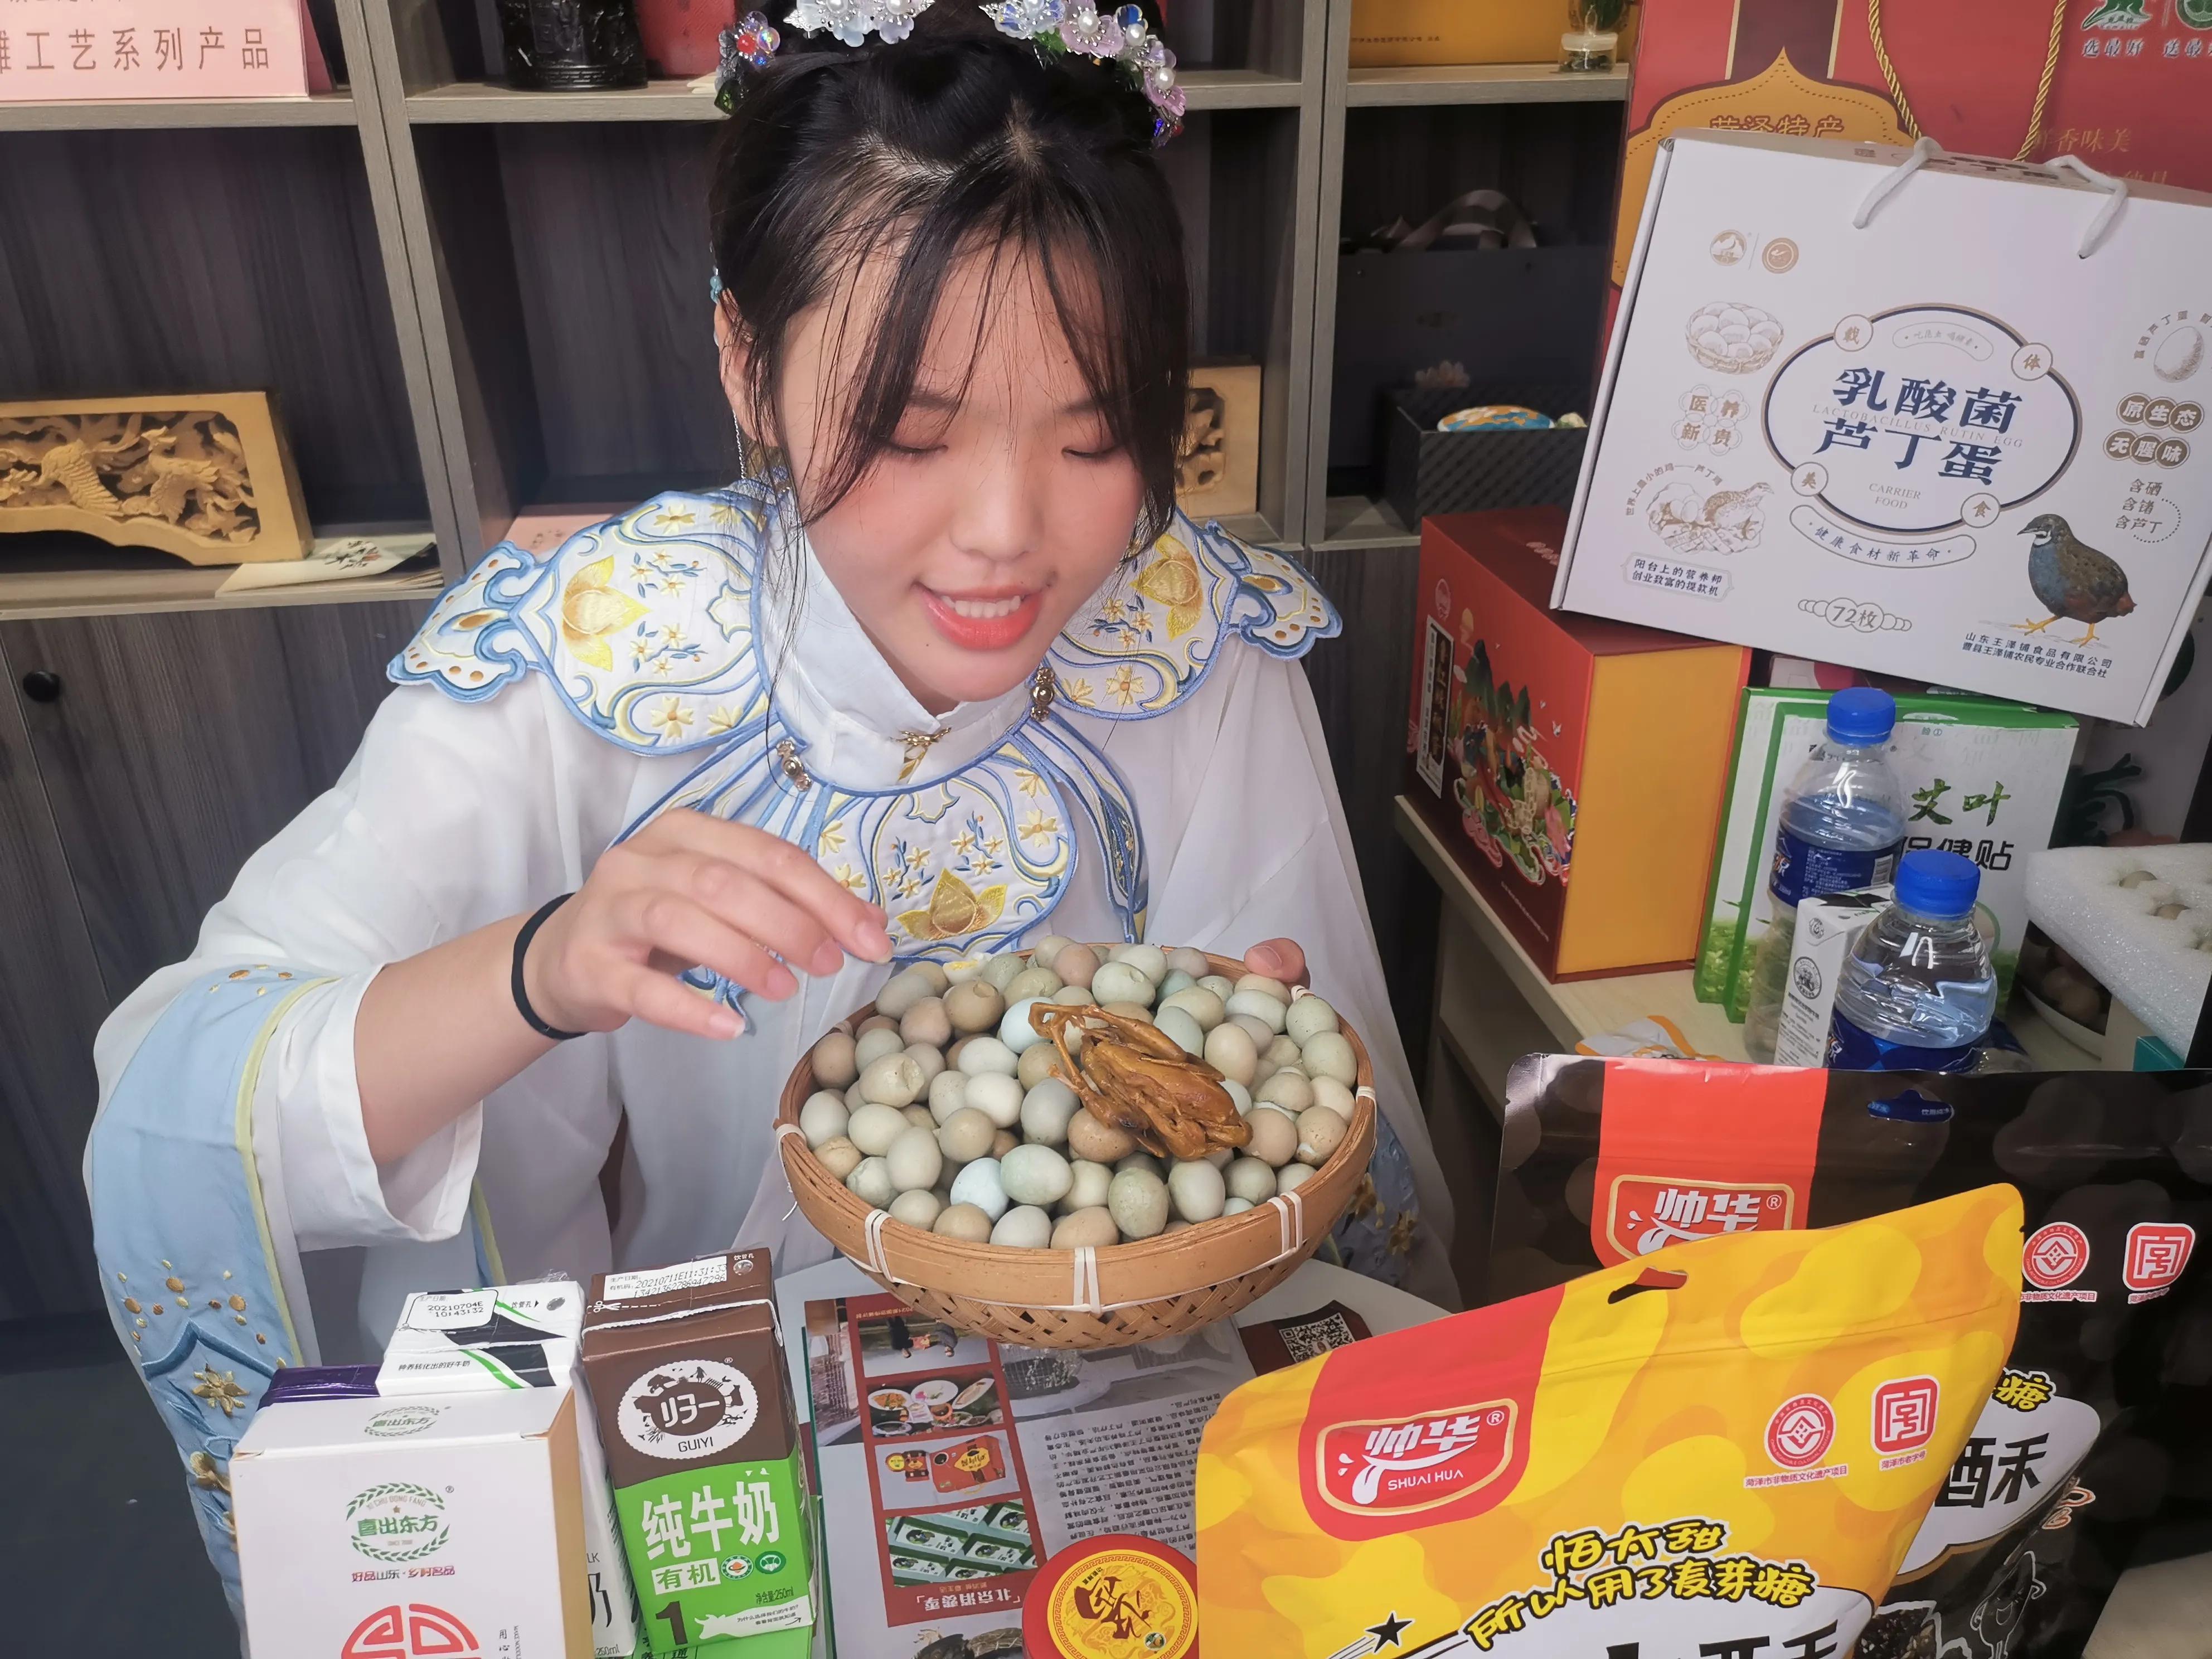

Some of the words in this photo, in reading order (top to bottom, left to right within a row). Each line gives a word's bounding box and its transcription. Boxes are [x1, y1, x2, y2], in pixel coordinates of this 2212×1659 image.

[0, 26, 269, 74] 工艺系列产品
[2023, 353, 2041, 371] 体
[1832, 367, 2023, 435] 乳酸菌
[2122, 400, 2197, 428] 原生态
[1812, 404, 1931, 432] LACTOBACILLUS
[1939, 426, 1985, 442] RUTIN
[1993, 435, 2023, 448] EGG
[1812, 418, 2002, 486] 芦丁蛋
[2108, 436, 2182, 463] 无腥味
[1869, 483, 1922, 500] CARRIER
[2129, 478, 2163, 497] 含硒
[1875, 496, 1908, 510] FOOD
[1972, 501, 1991, 518] 食
[2115, 515, 2162, 535] 含芦丁
[1632, 570, 1719, 596] 创业致富的提款机
[1634, 558, 1723, 584] 阳台上的营养师
[1832, 605, 1879, 629] 72枚
[1908, 778, 2011, 827] 艾叶
[1653, 1187, 1760, 1231] 帅华
[427, 1301, 484, 1312] 20210704E
[1991, 1377, 2050, 1409] 糖
[678, 1436, 714, 1453] GUIYI
[1364, 1415, 1481, 1459] 帅华
[1388, 1473, 1431, 1491] SHUAI
[1434, 1468, 1464, 1482] HUA
[641, 1481, 779, 1560] 纯牛奶
[656, 1562, 716, 1590] 有机
[1468, 1559, 1815, 1650] 所以用了麦芽糖
[655, 1600, 688, 1646] 1
